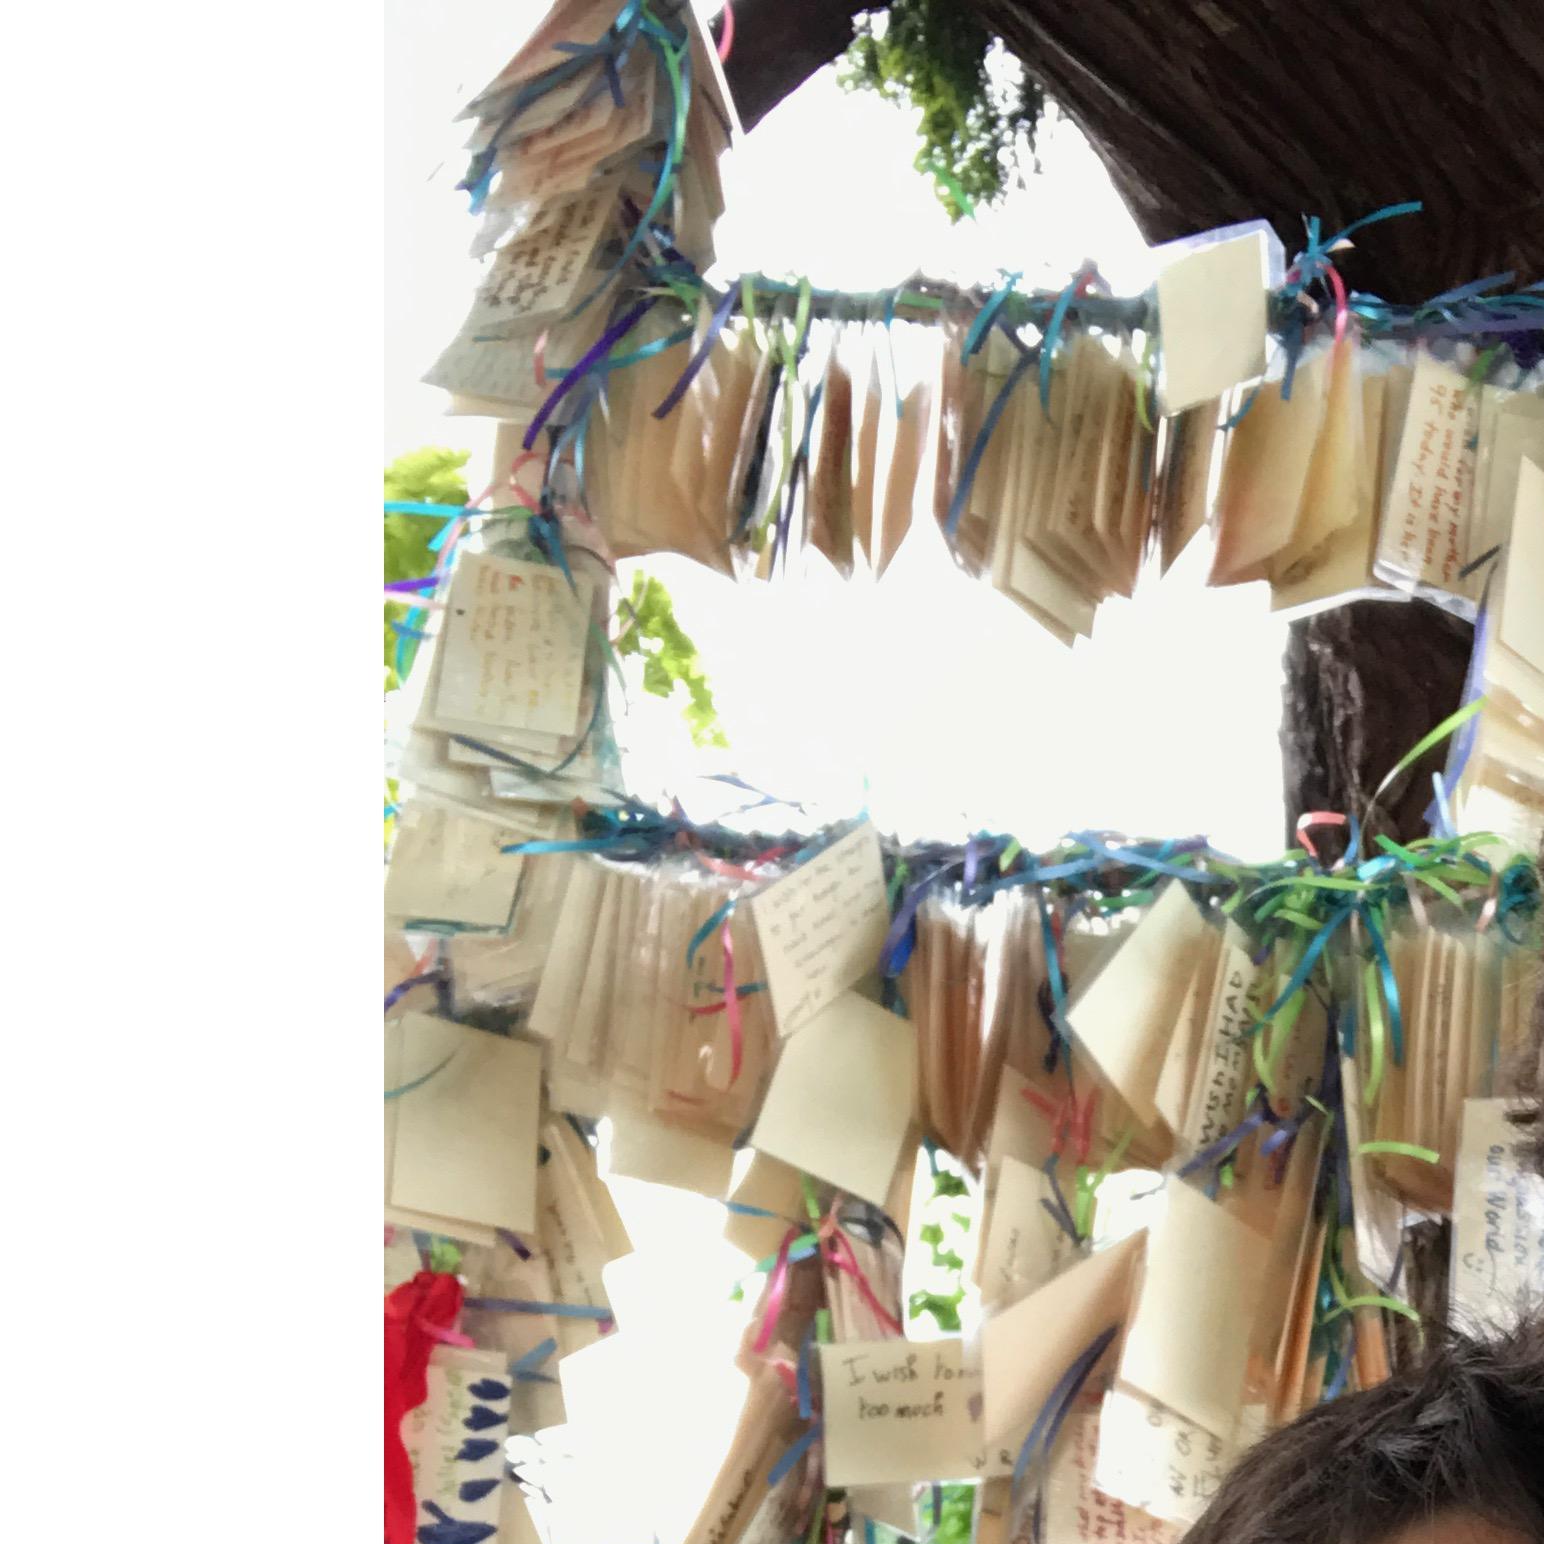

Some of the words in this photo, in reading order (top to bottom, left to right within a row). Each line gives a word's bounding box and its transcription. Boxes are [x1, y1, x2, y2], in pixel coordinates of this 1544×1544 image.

[1486, 1144, 1505, 1181] our
[841, 1354, 870, 1386] I
[871, 1353, 919, 1383] wish
